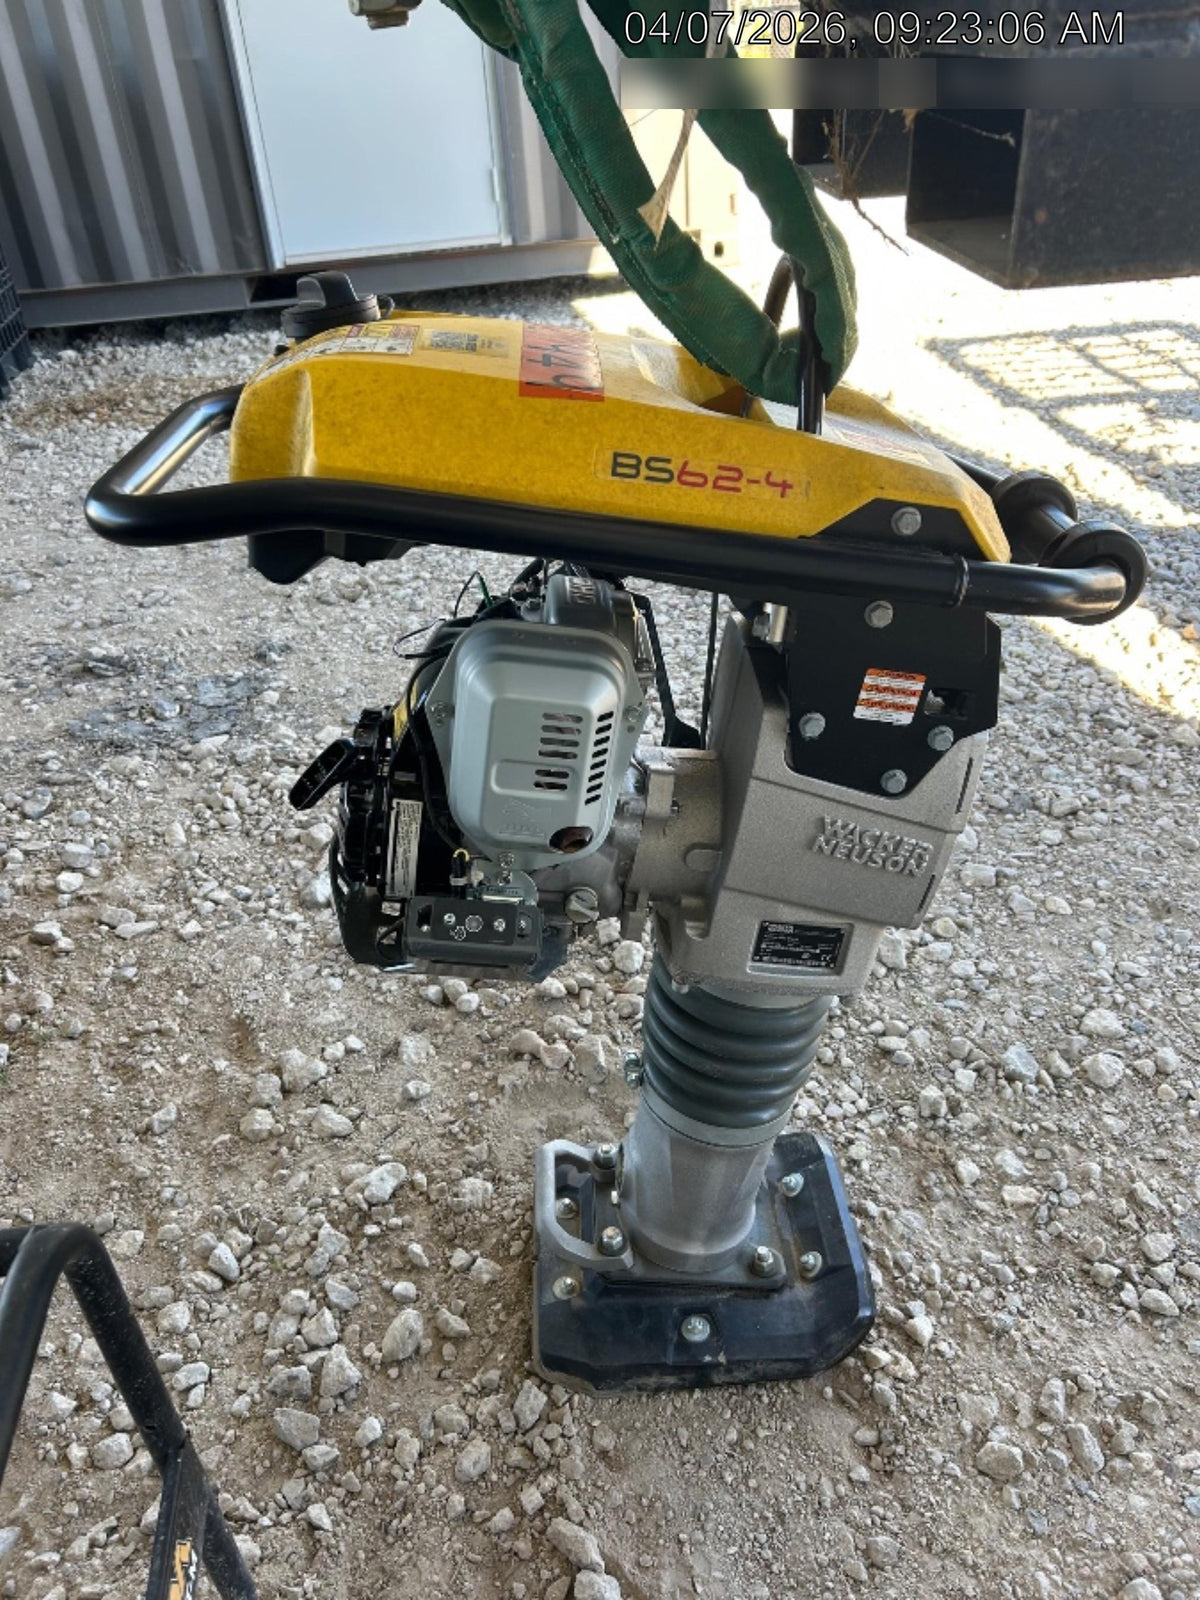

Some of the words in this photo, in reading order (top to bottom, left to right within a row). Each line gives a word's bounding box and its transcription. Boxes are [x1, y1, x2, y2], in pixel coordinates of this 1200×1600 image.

[610, 451, 794, 498] BS62-4
[812, 835, 928, 877] NEUSON
[823, 813, 934, 862] WACKER
